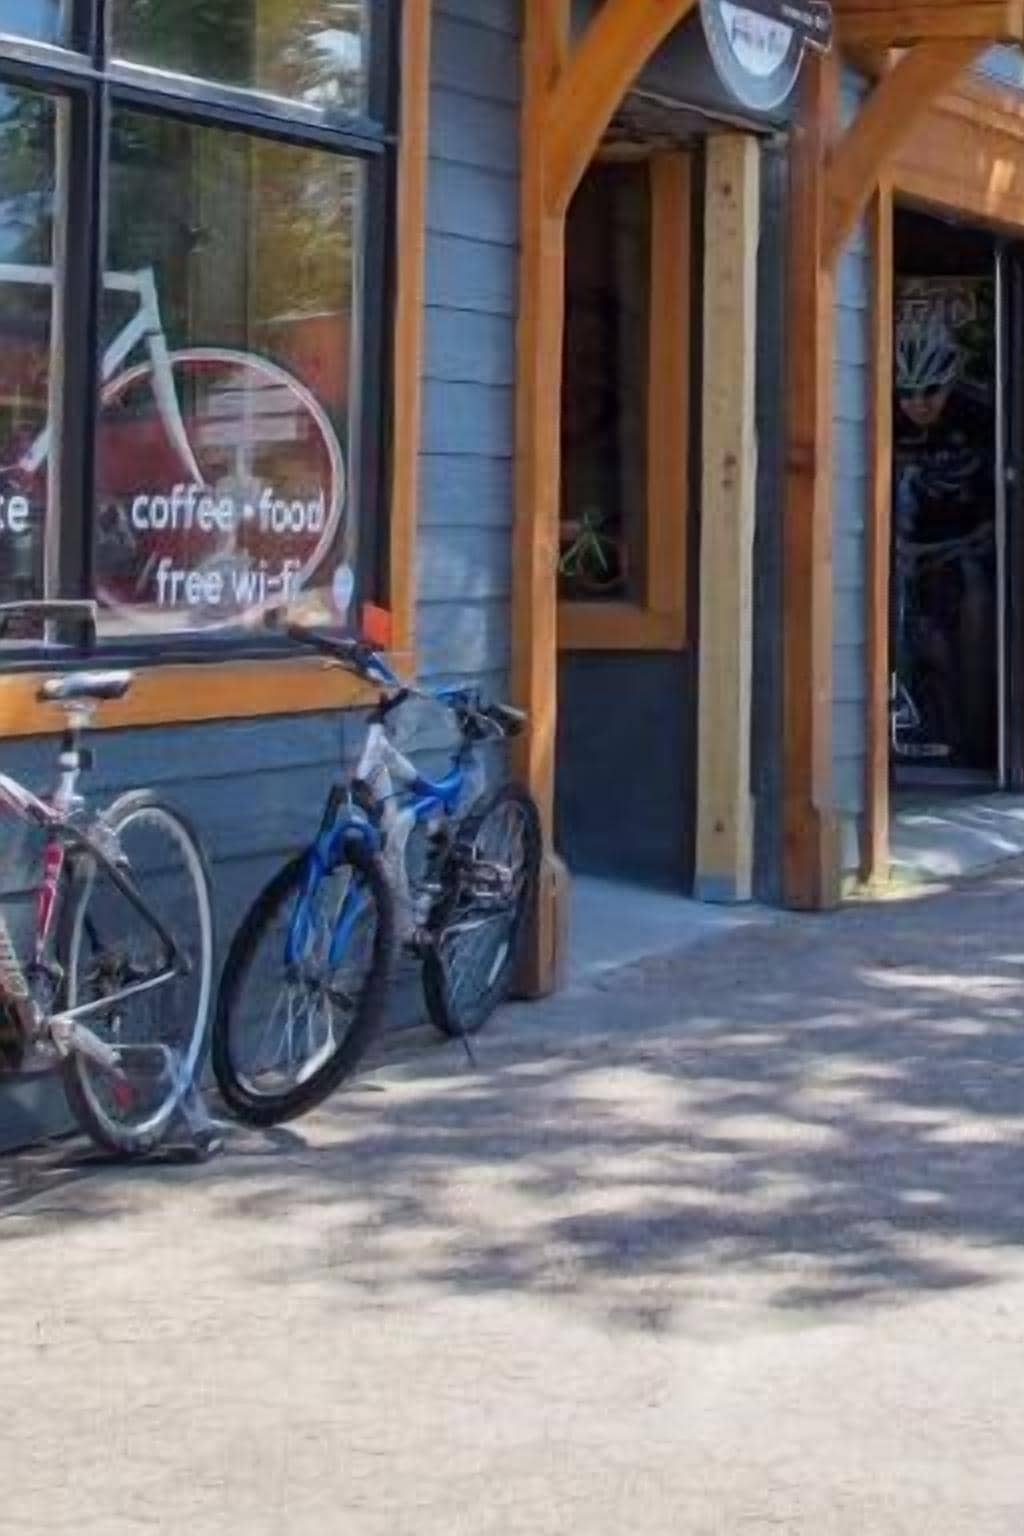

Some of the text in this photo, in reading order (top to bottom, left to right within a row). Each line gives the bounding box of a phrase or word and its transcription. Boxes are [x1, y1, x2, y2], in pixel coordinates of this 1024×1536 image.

[0, 495, 29, 532] e
[131, 483, 325, 533] coffee food
[156, 557, 223, 606] free
